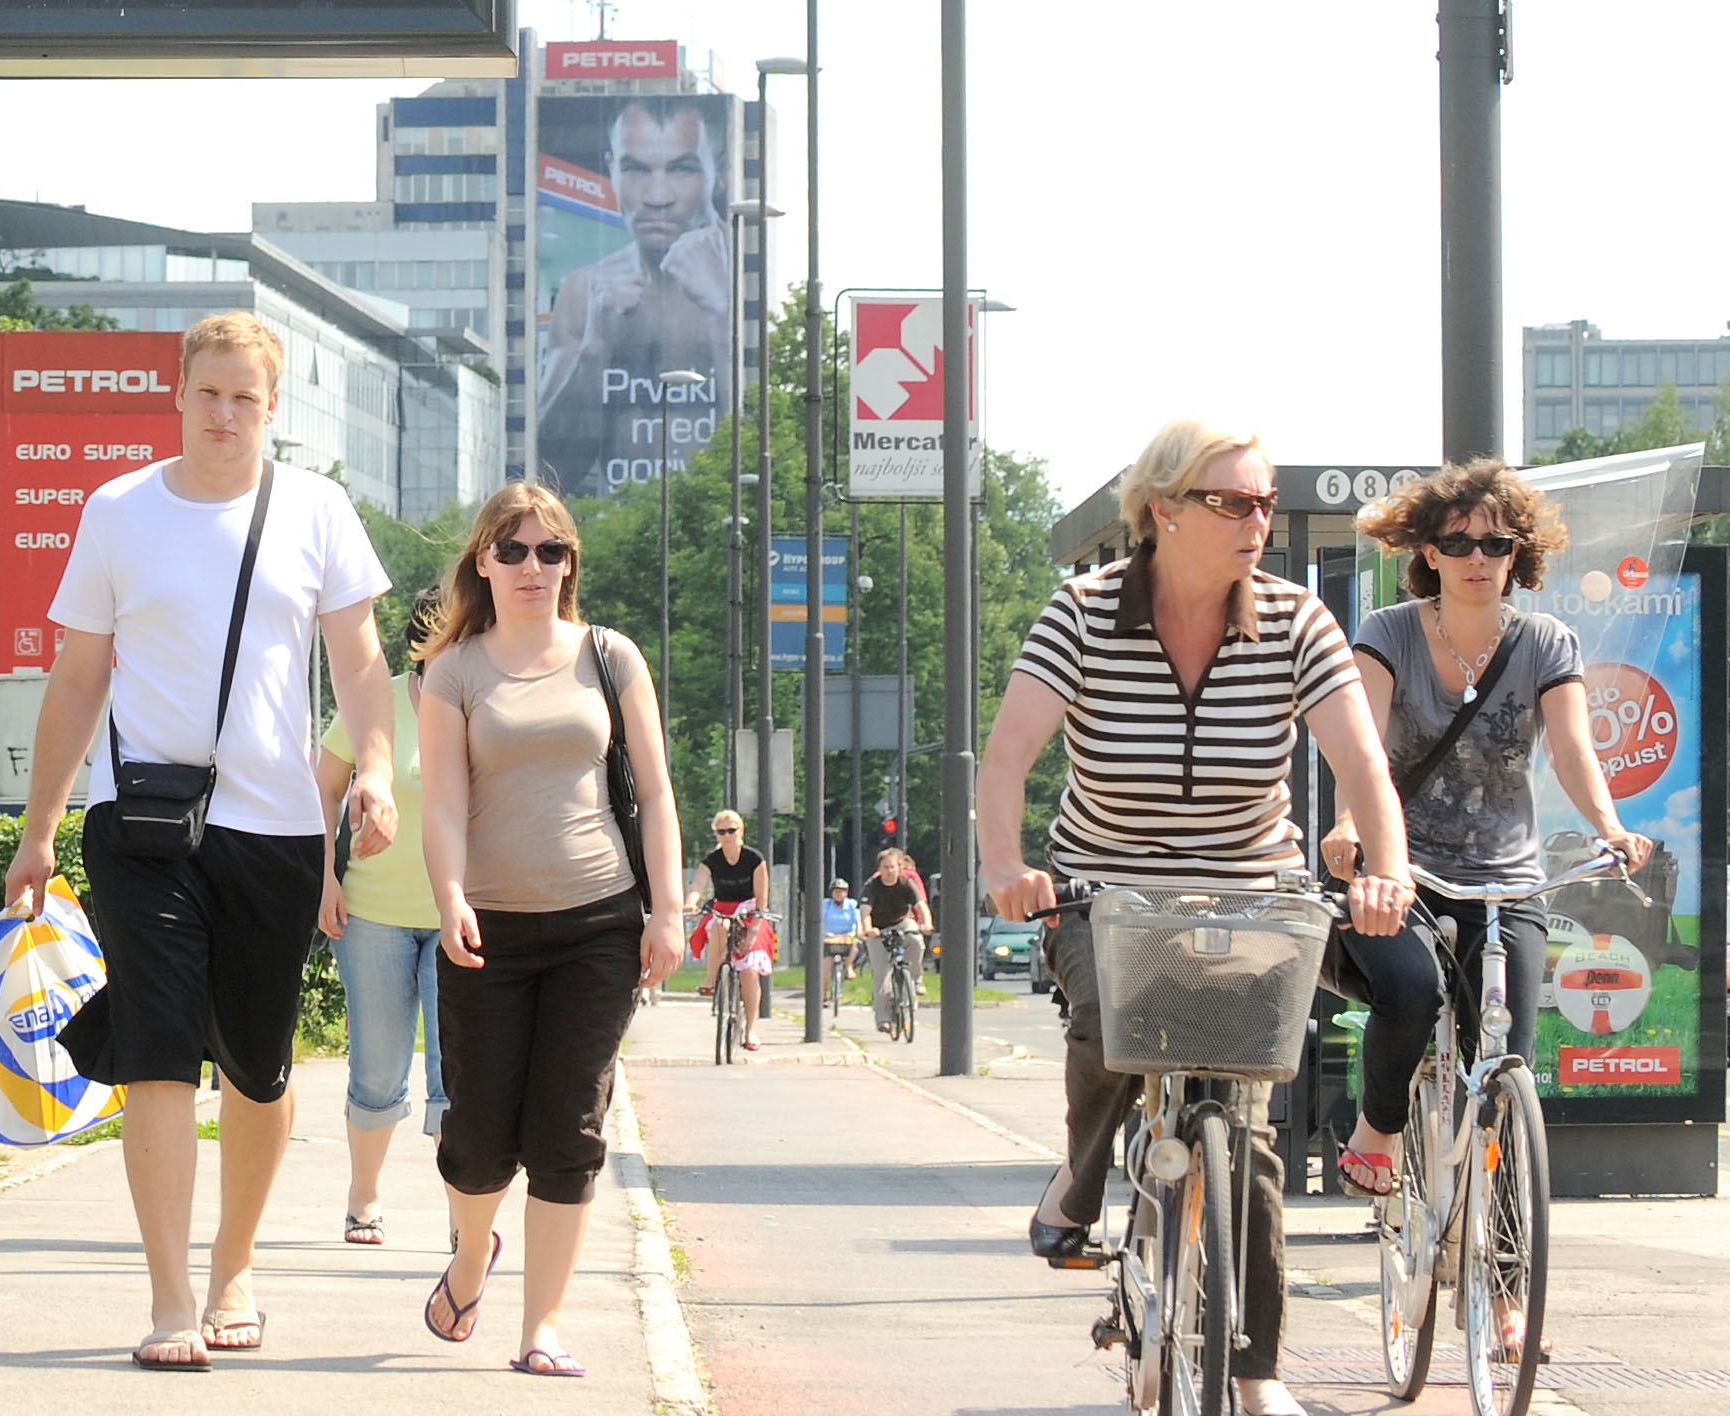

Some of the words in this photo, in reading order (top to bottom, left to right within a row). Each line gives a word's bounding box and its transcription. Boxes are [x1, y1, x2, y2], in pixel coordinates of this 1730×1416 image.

[562, 51, 665, 68] PETROL
[544, 165, 607, 199] PETROL
[13, 370, 170, 393] PETROL
[603, 368, 715, 404] Prvaki
[632, 408, 715, 444] med
[854, 433, 977, 451] Mercar
[15, 444, 71, 461] EURO
[83, 444, 153, 461] SUPER
[15, 488, 84, 505] SUPER
[1326, 475, 1340, 498] 6
[1364, 475, 1376, 498] 8
[15, 533, 70, 549] EURO
[1573, 1059, 1668, 1073] PETROL
